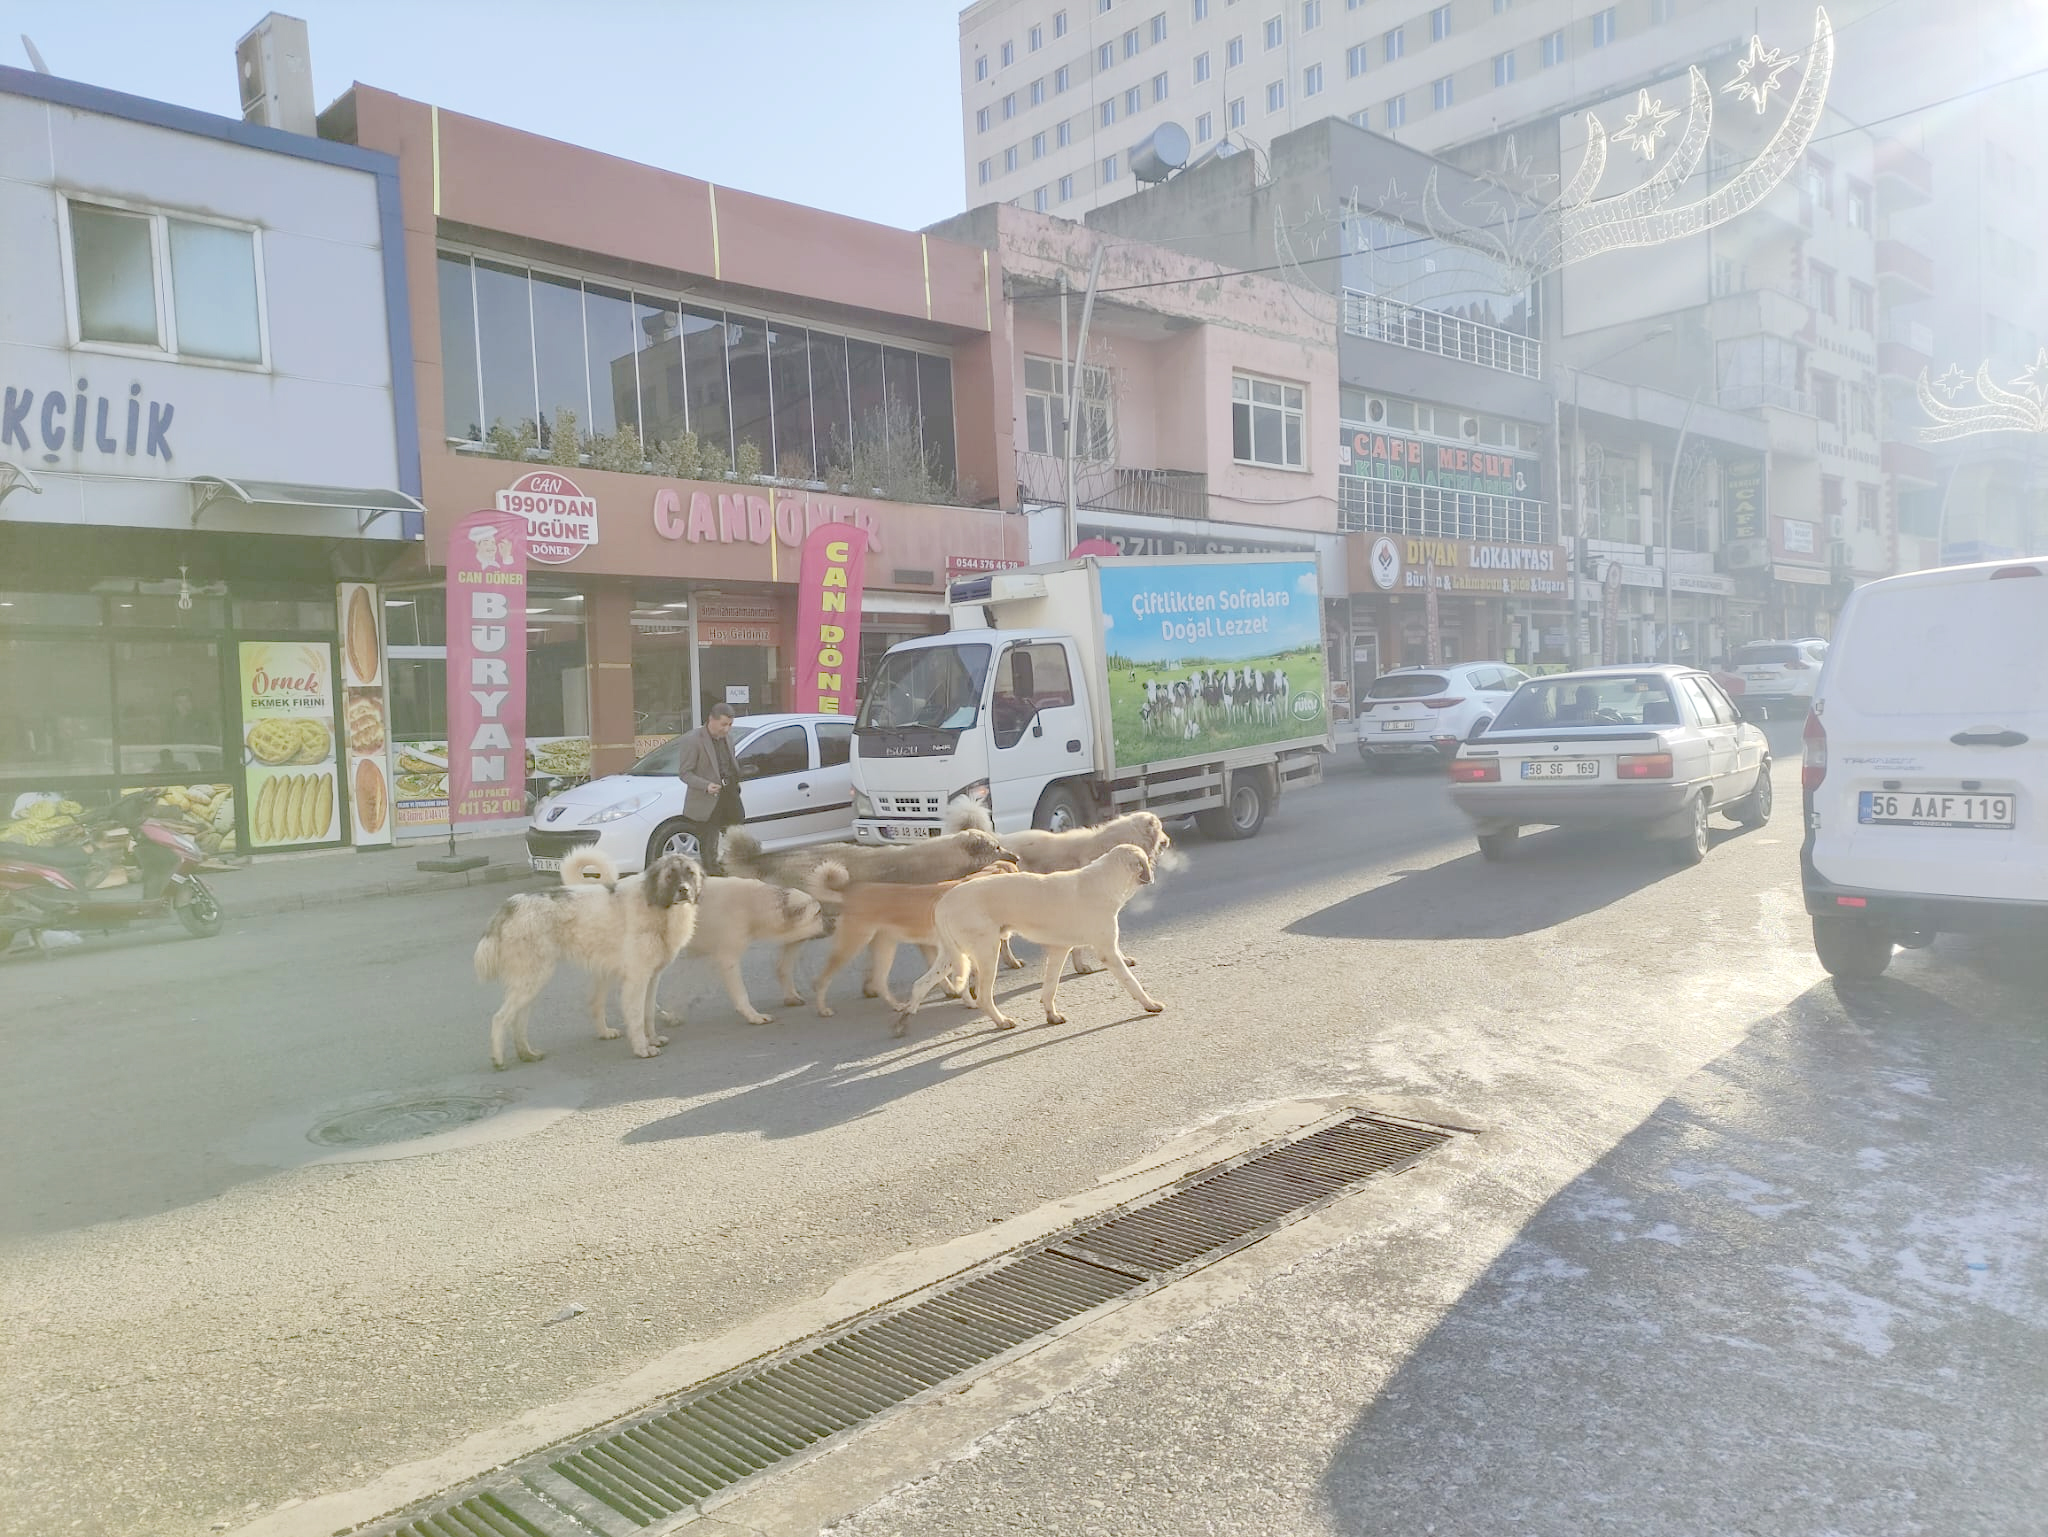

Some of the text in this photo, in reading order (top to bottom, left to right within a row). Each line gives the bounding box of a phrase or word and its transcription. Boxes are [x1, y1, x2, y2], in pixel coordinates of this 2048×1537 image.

[2, 378, 175, 463] KÇİLİK
[1354, 433, 1513, 478] CAFE MESUT
[531, 477, 562, 493] CAN
[502, 494, 594, 518] 1990'DAN
[526, 518, 590, 540] UGÜNE
[532, 544, 571, 556] DÖNER
[1406, 538, 1555, 572] DİVAN LOKANTASI
[956, 558, 978, 569] 0544
[980, 560, 995, 570] 376
[458, 571, 524, 585] CAN DÖNER
[1132, 588, 1290, 620] Çiftlikten Sofralara
[1161, 615, 1269, 643] Doğal Lezzet
[252, 666, 319, 695] Örnek
[817, 624, 845, 714] DÖNE
[469, 591, 513, 783] BURYAN
[250, 698, 325, 708] EKMEK FIRINI
[885, 745, 918, 757] ISUZU
[1529, 764, 1543, 775] 58
[1577, 763, 1595, 774] 169
[458, 800, 479, 816] 411
[481, 800, 500, 814] 52
[502, 799, 521, 813] 00
[1872, 796, 1898, 816] 56
[1911, 797, 1955, 819] AAF
[1964, 798, 2007, 820] 119
